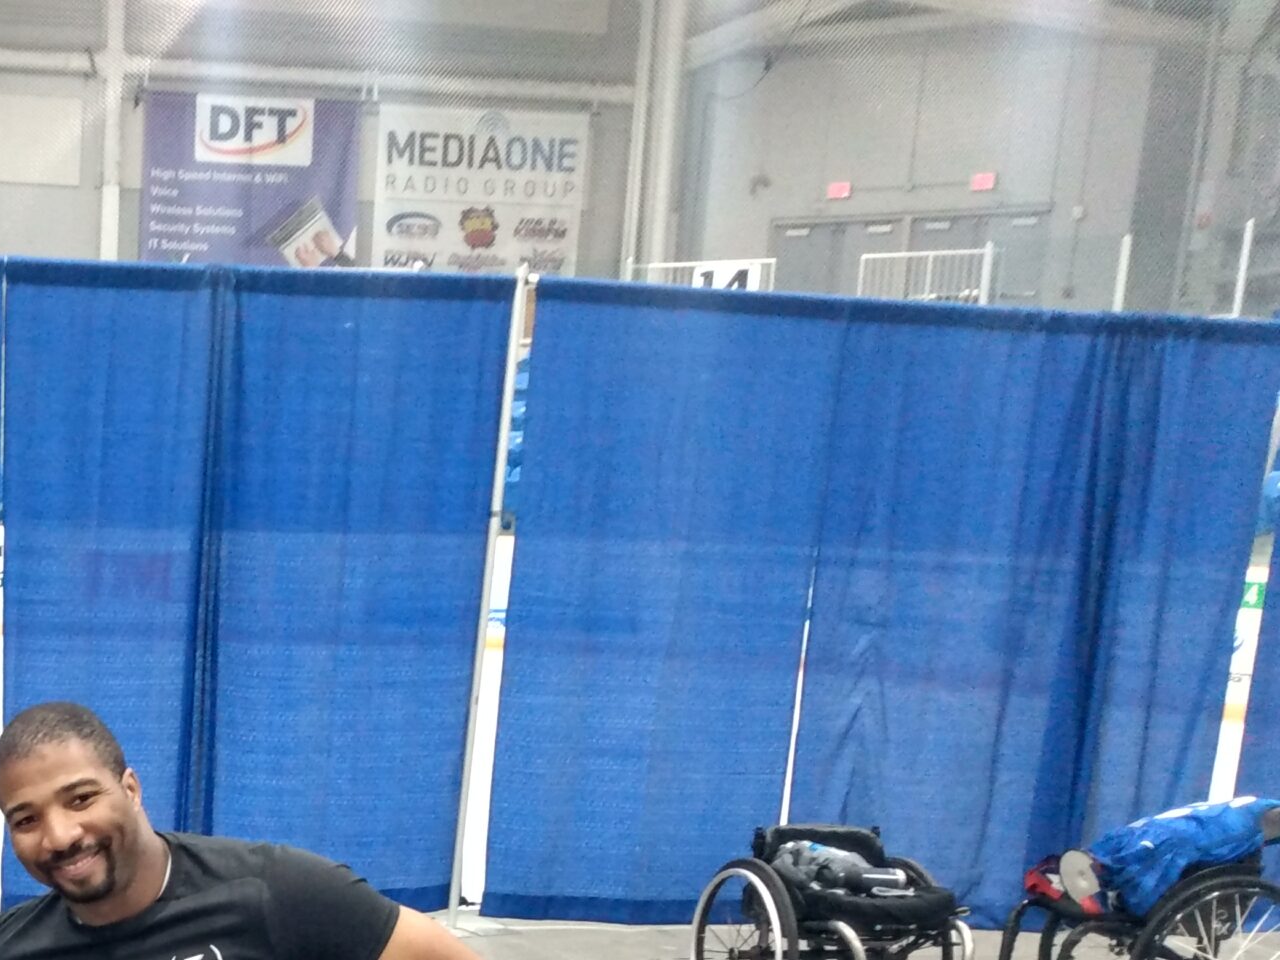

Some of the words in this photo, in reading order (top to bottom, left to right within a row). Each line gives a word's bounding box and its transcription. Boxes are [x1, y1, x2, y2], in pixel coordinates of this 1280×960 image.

[208, 104, 298, 145] DFT
[386, 130, 579, 173] MEDIAONE
[150, 168, 177, 181] High
[177, 168, 212, 182] Speed
[150, 184, 180, 198] Voice
[384, 173, 470, 196] RADIO
[483, 177, 576, 199] GROUP
[150, 203, 194, 217] Wireless
[195, 205, 244, 218] Solutions
[149, 220, 192, 235] Security
[193, 222, 237, 236] Systems
[148, 237, 160, 250] IT
[160, 239, 209, 251] Solutions
